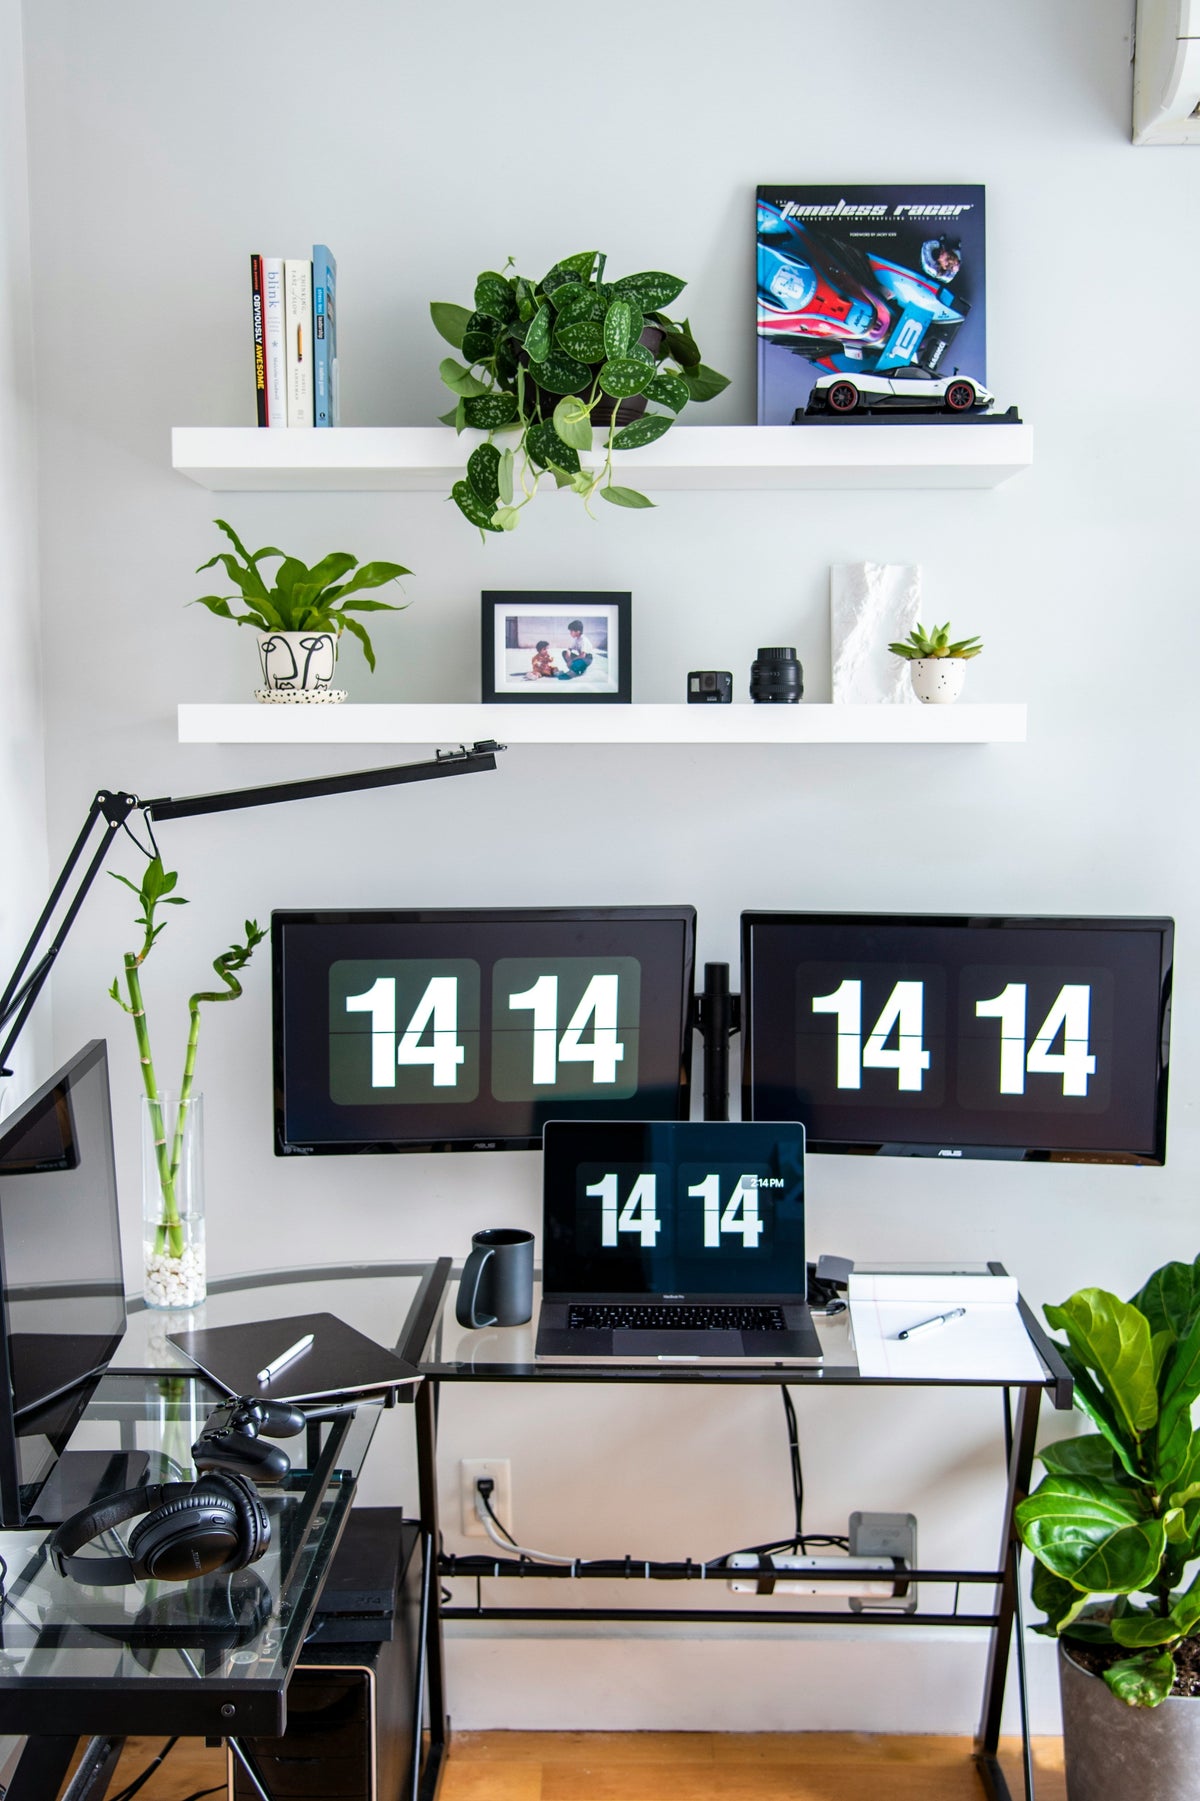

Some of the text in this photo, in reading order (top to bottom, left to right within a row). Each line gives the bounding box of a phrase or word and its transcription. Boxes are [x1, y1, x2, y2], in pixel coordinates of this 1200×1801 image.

[892, 204, 971, 216] racer
[267, 271, 280, 308] blink
[253, 294, 263, 344] OBVIOUSLY
[255, 344, 265, 390] AWESOME
[346, 974, 625, 1088] 14 14
[812, 980, 1097, 1097] 14 14
[937, 1149, 963, 1158] ASUS
[750, 1178, 785, 1188] 2:14 PM
[586, 1173, 764, 1248] 14 14
